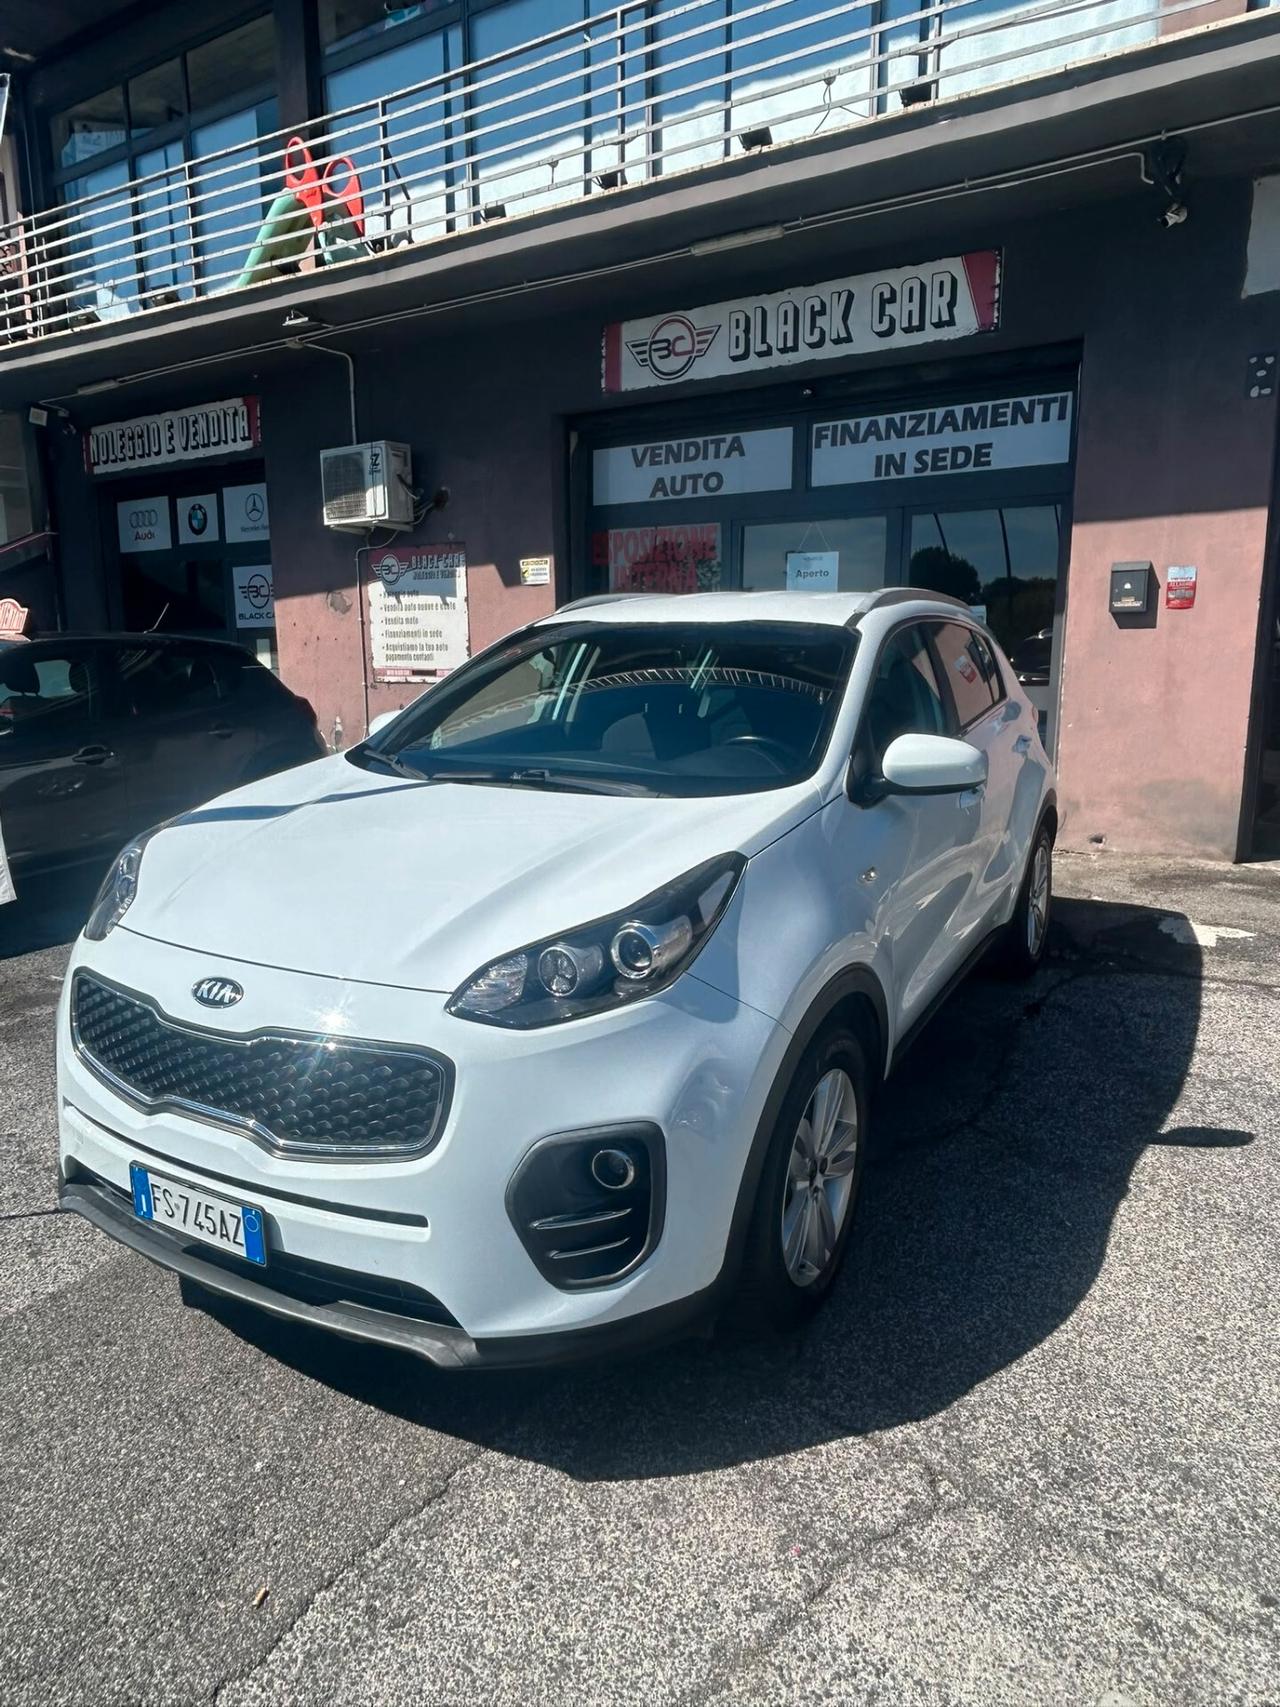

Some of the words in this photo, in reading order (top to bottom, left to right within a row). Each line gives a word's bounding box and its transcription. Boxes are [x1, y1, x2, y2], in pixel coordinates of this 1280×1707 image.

[728, 290, 855, 362] BLACK
[871, 271, 957, 338] CAR
[89, 422, 161, 465] NOLEGGIO
[165, 419, 175, 454] E
[178, 405, 251, 451] VENDITA
[814, 394, 1069, 449] FINANZIAMENTI
[631, 435, 746, 468] VENDITA
[874, 452, 906, 478] IN
[913, 442, 993, 474] SEDE
[649, 471, 724, 499] AUTO
[135, 531, 155, 541] Audi
[796, 569, 830, 580] Aperto
[196, 980, 234, 1003] KIA
